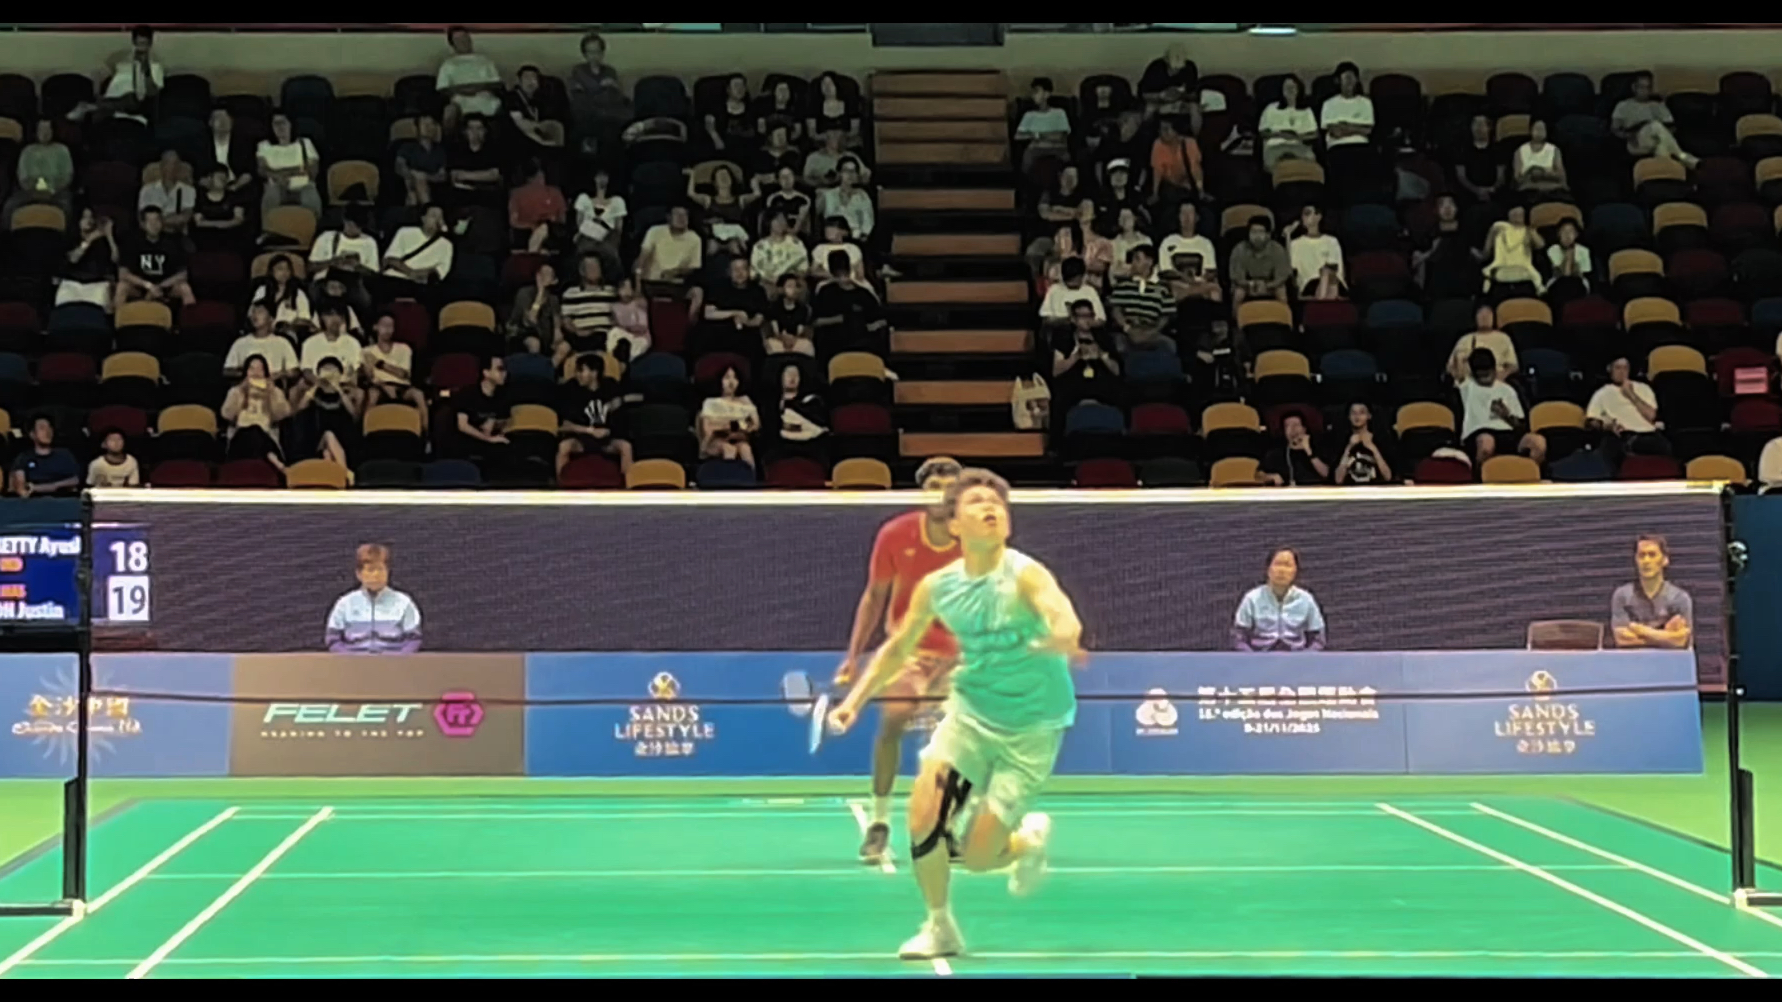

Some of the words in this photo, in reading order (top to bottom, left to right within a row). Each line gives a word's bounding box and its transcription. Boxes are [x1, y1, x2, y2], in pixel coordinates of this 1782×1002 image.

[0, 536, 37, 554] ETTY
[109, 540, 148, 572] 18
[112, 585, 146, 615] 19
[263, 703, 423, 723] FELET
[629, 705, 699, 721] SANDS
[1508, 703, 1579, 719] SANDS
[615, 723, 714, 739] LIFESTYLE
[1494, 720, 1595, 737] LIFESTYLE
